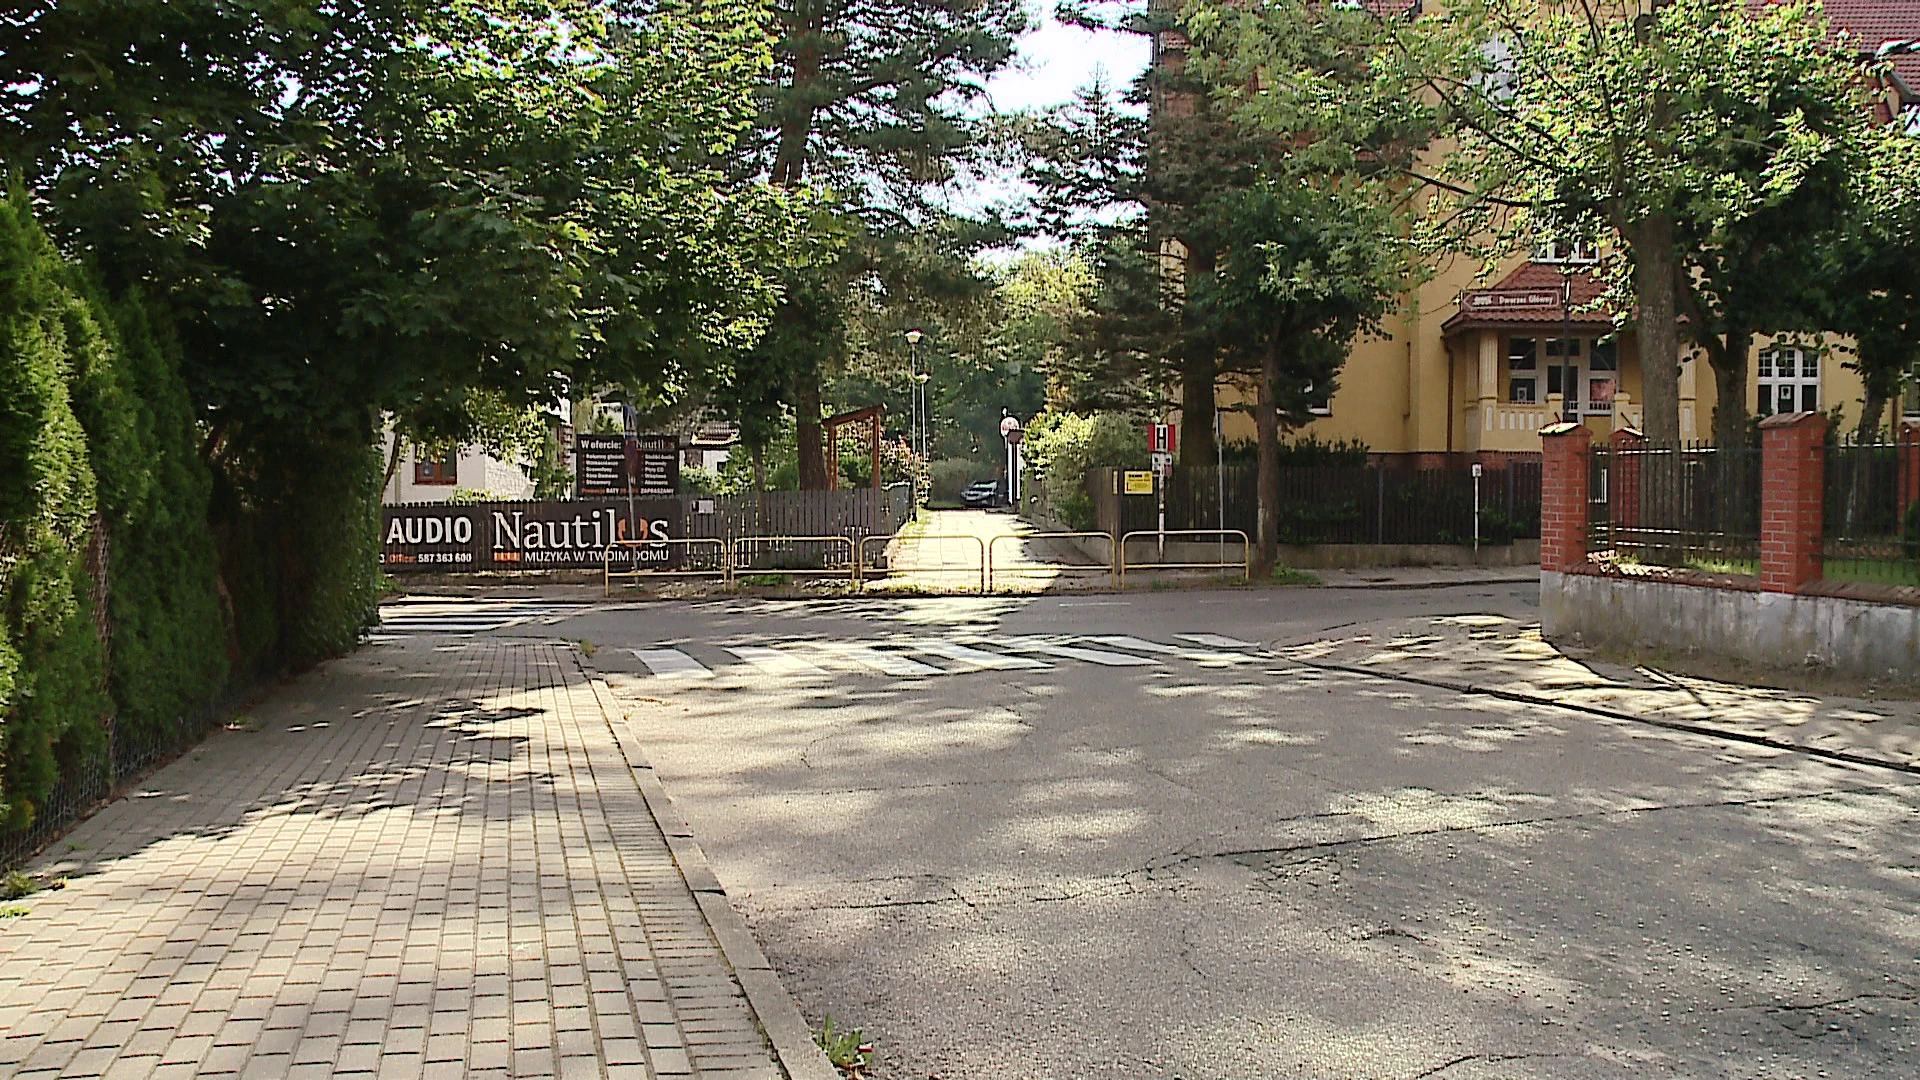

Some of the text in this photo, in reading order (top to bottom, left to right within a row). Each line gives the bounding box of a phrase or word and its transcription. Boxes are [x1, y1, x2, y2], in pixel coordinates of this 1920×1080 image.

[581, 439, 622, 449] W ofercie:
[1156, 427, 1167, 449] H
[386, 516, 472, 544] AUDIO
[492, 509, 669, 549] Nautilus
[418, 553, 435, 563] 587
[436, 553, 453, 563] 363
[455, 553, 472, 563] 600
[525, 551, 571, 562] MUZYKA
[573, 551, 586, 562] W
[588, 550, 629, 562] TWOIM
